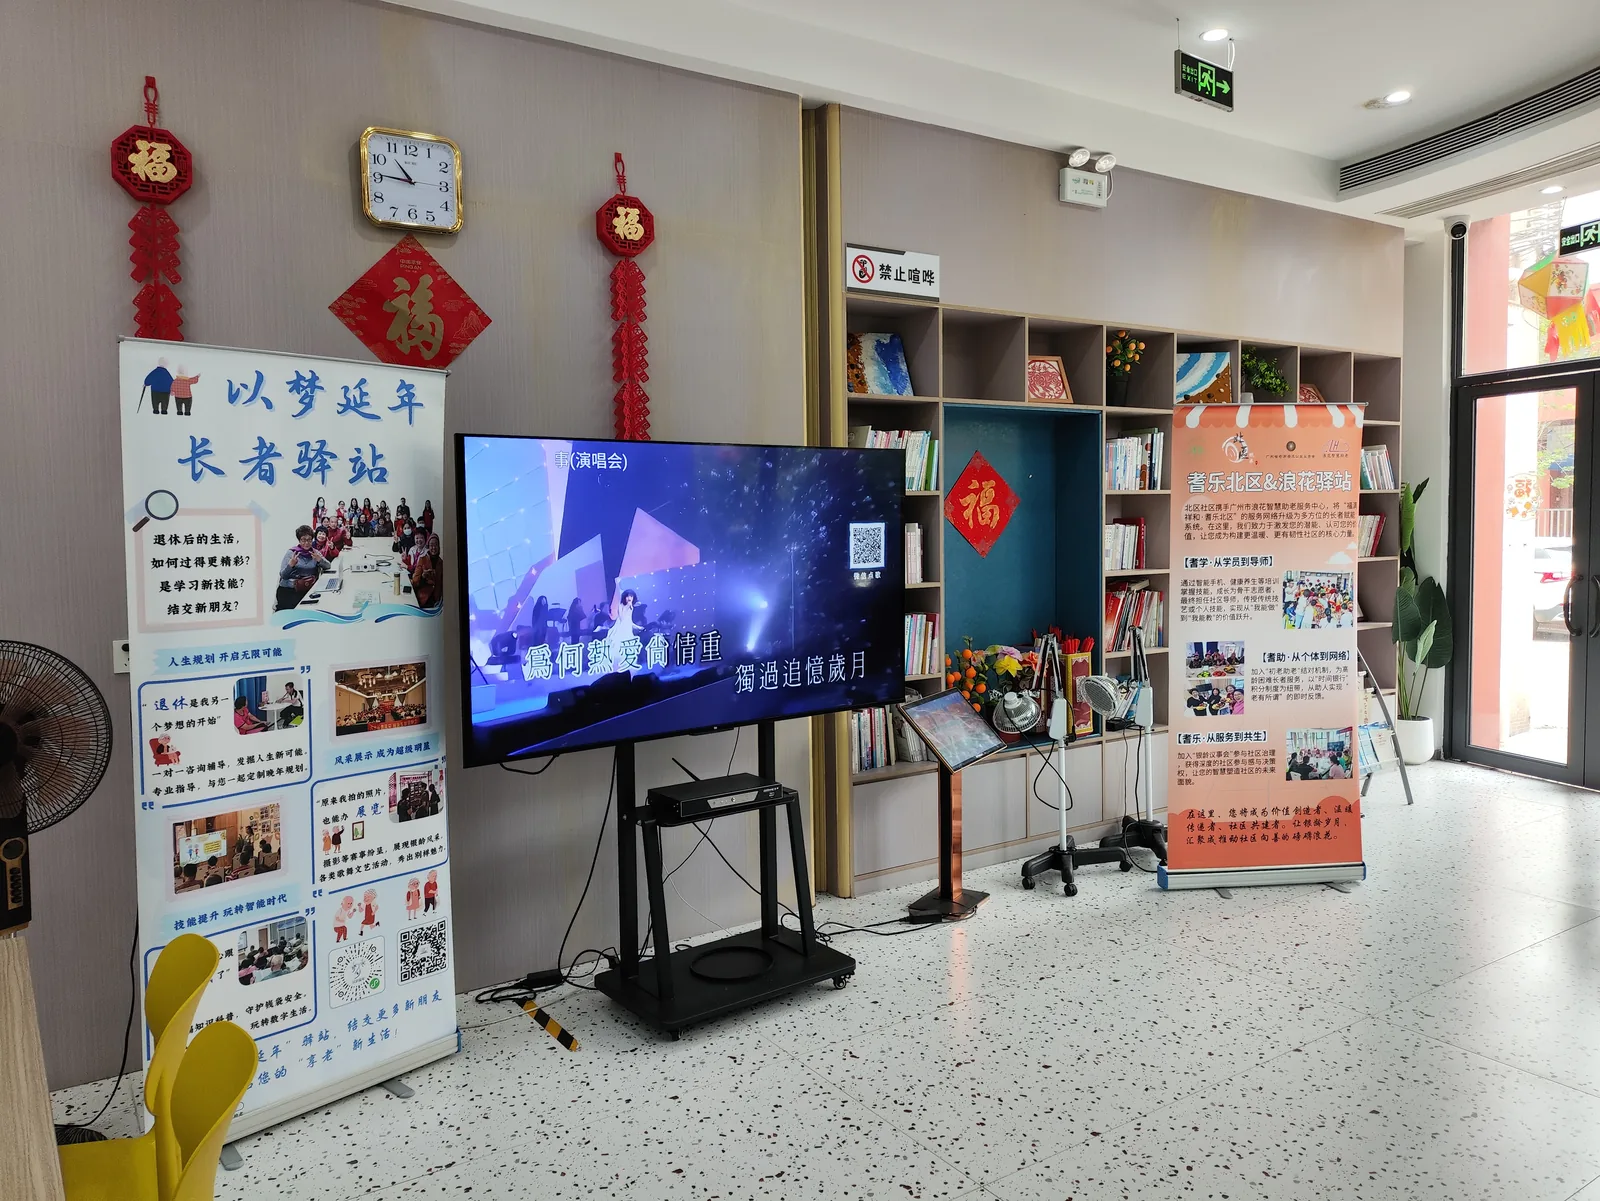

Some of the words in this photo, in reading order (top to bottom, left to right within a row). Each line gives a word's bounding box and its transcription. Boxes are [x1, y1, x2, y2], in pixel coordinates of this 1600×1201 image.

[1182, 73, 1197, 84] EXIT
[387, 142, 398, 153] 11
[404, 145, 418, 157] 12
[426, 148, 432, 158] 1
[128, 139, 177, 183] 福
[373, 154, 386, 165] 10
[439, 162, 449, 173] 2
[373, 172, 383, 183] 9
[439, 181, 449, 192] 3
[373, 191, 384, 203] 8
[389, 206, 398, 217] 7
[440, 201, 449, 212] 4
[408, 208, 418, 220] 6
[426, 211, 435, 222] 5
[612, 205, 645, 241] 福
[879, 263, 935, 286] 禁止喧哗
[382, 273, 444, 360] 福
[227, 369, 424, 426] 以梦延年
[177, 435, 388, 486] 长者驿站
[555, 450, 628, 472] 事(演唱会)
[1187, 471, 1352, 493] 耆乐北区&浪花驿站
[958, 479, 1000, 529] 福
[168, 652, 215, 667] 人生规划
[219, 647, 283, 662] 开启无限可能
[734, 650, 865, 694] 獨過追憶歲月
[334, 751, 373, 765] 风采展示
[173, 911, 219, 931] 技能提升
[222, 893, 288, 918] 玩转智能时代
